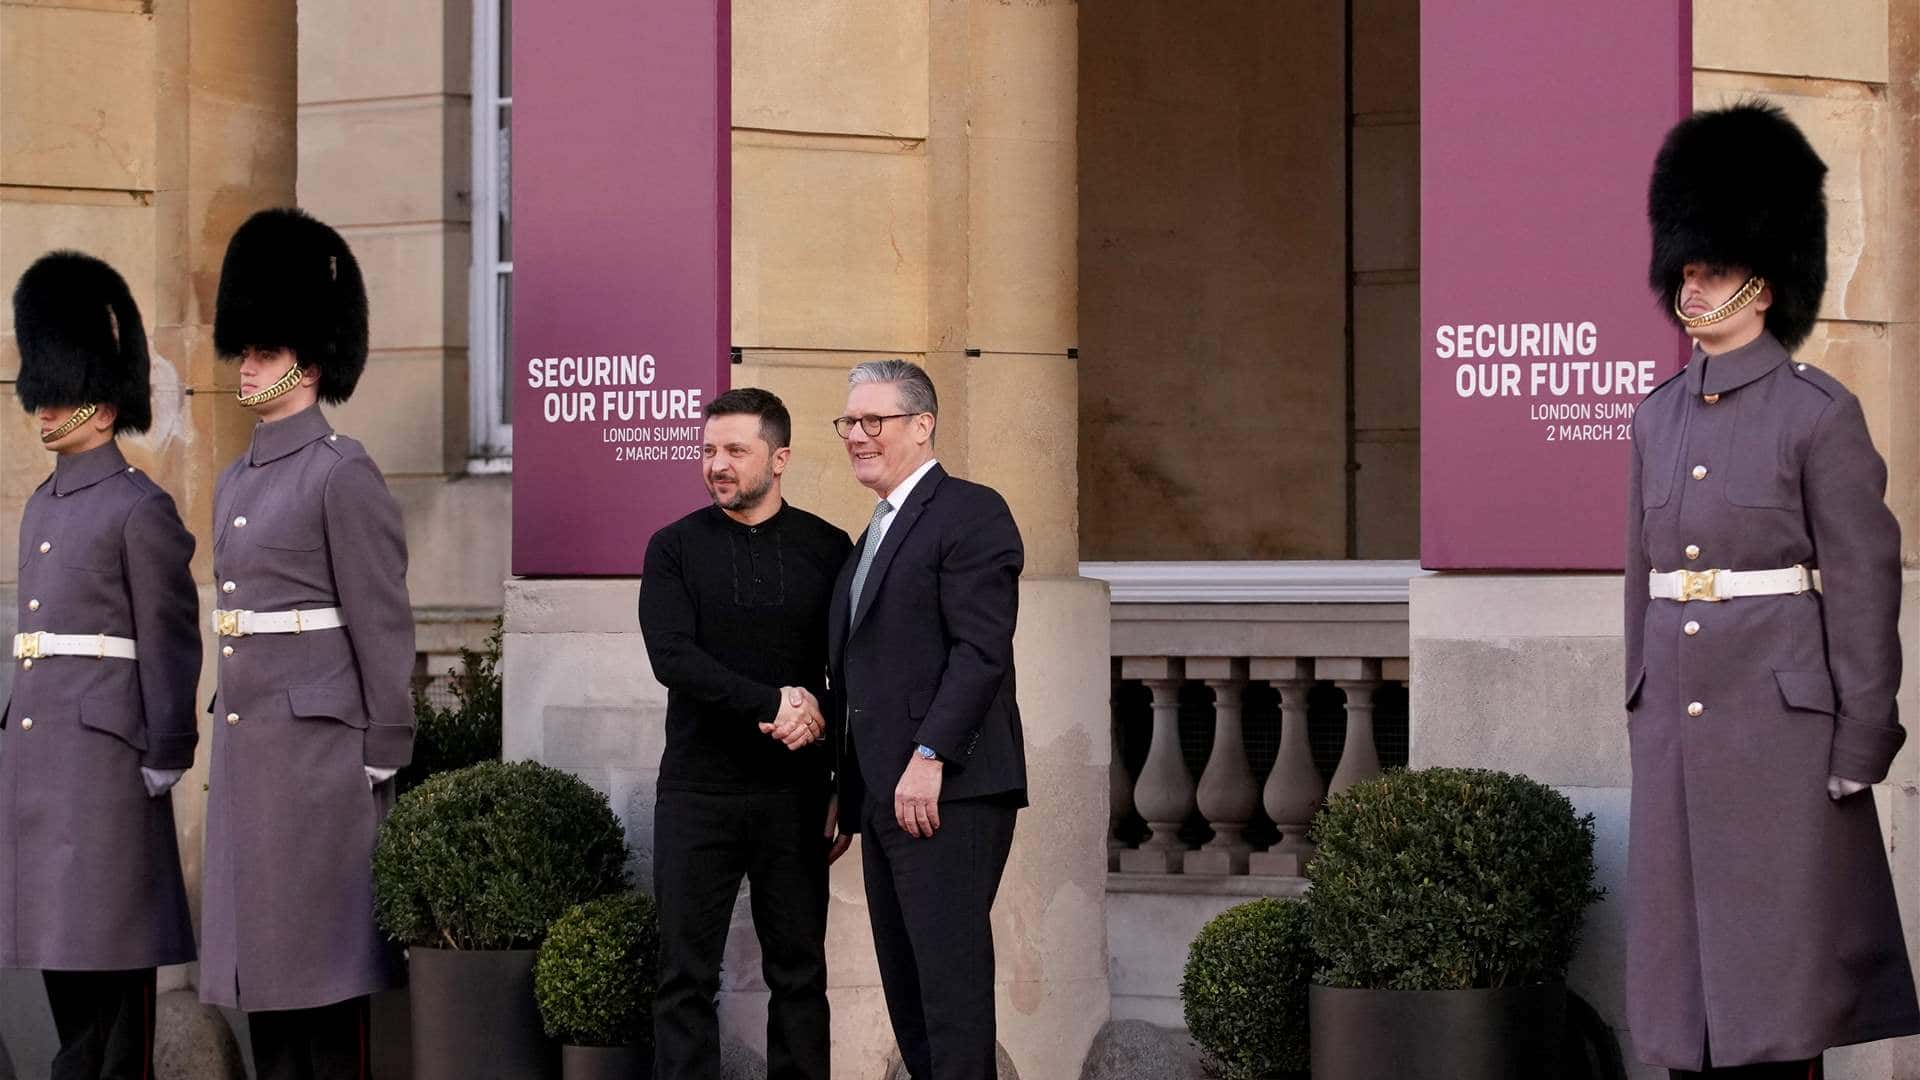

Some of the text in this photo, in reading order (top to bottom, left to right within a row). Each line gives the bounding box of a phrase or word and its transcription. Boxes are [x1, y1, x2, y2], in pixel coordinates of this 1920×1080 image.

[1436, 322, 1597, 358] SECURING
[528, 354, 656, 388] SECURING
[1456, 361, 1656, 397] OUR FUTURE
[544, 389, 702, 423] OUR FUTURE
[1531, 403, 1639, 420] LONDON SUMM
[603, 427, 701, 442] LONDON SUMMIT
[1546, 425, 1632, 441] 2 MARCH 20
[616, 446, 701, 460] 2 MARCH 2025
